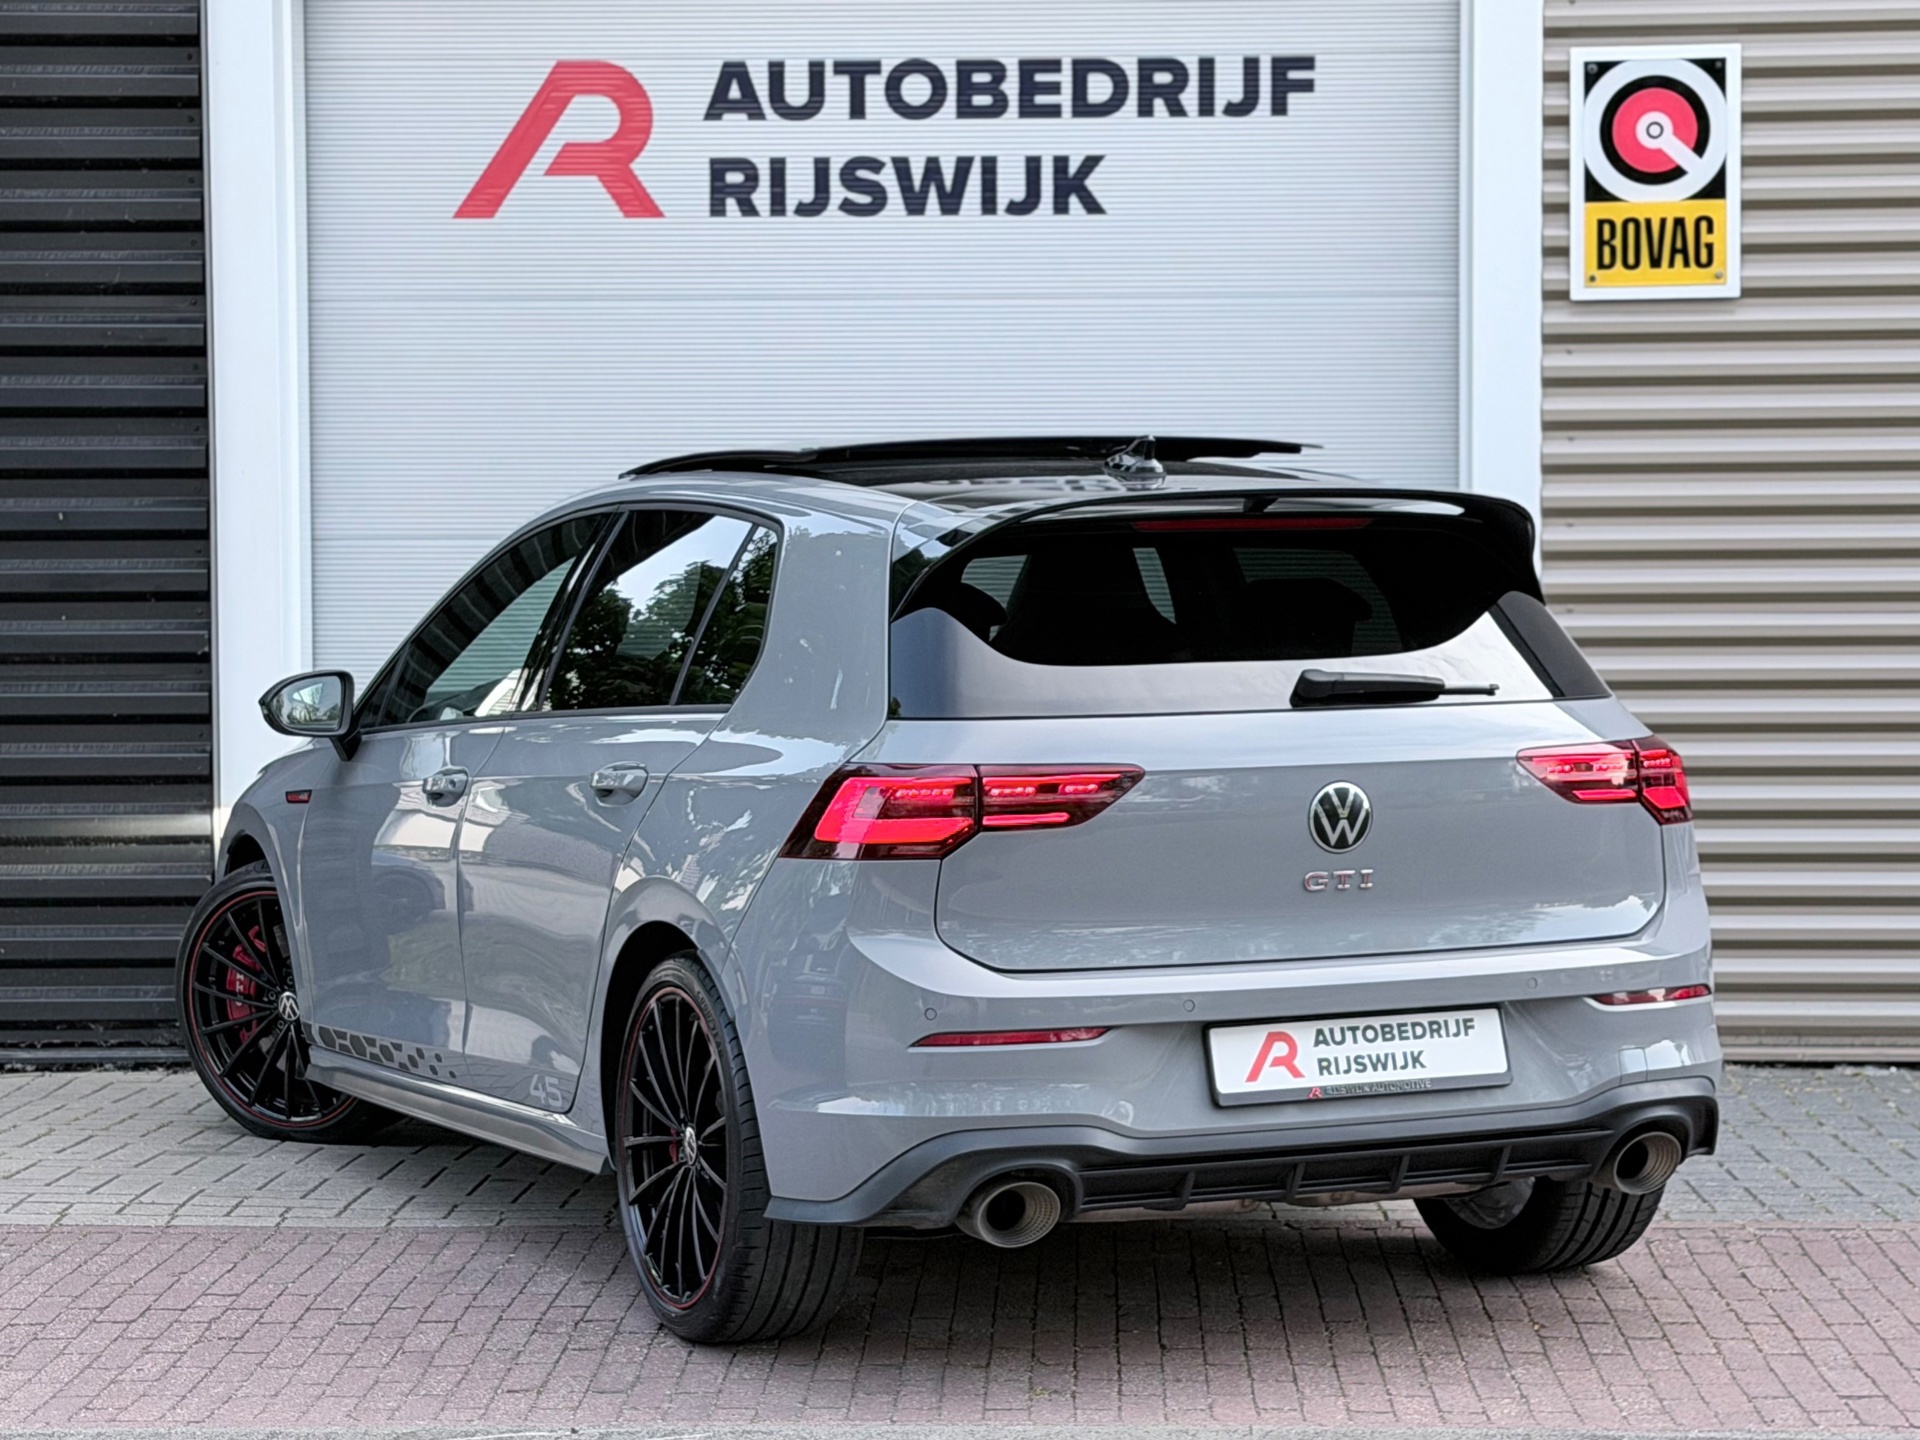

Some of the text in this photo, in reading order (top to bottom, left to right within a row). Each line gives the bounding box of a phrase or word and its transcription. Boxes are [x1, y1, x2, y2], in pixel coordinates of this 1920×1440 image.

[704, 55, 1316, 121] AUTOBEDRIJF
[709, 154, 1107, 218] RIJSWIJK
[1596, 215, 1714, 271] BOVAG
[1304, 868, 1374, 891] GTI
[1313, 1017, 1475, 1048] AUTOBEDRIJF
[1317, 1050, 1426, 1076] RIJSWIJK
[530, 1074, 562, 1107] 45
